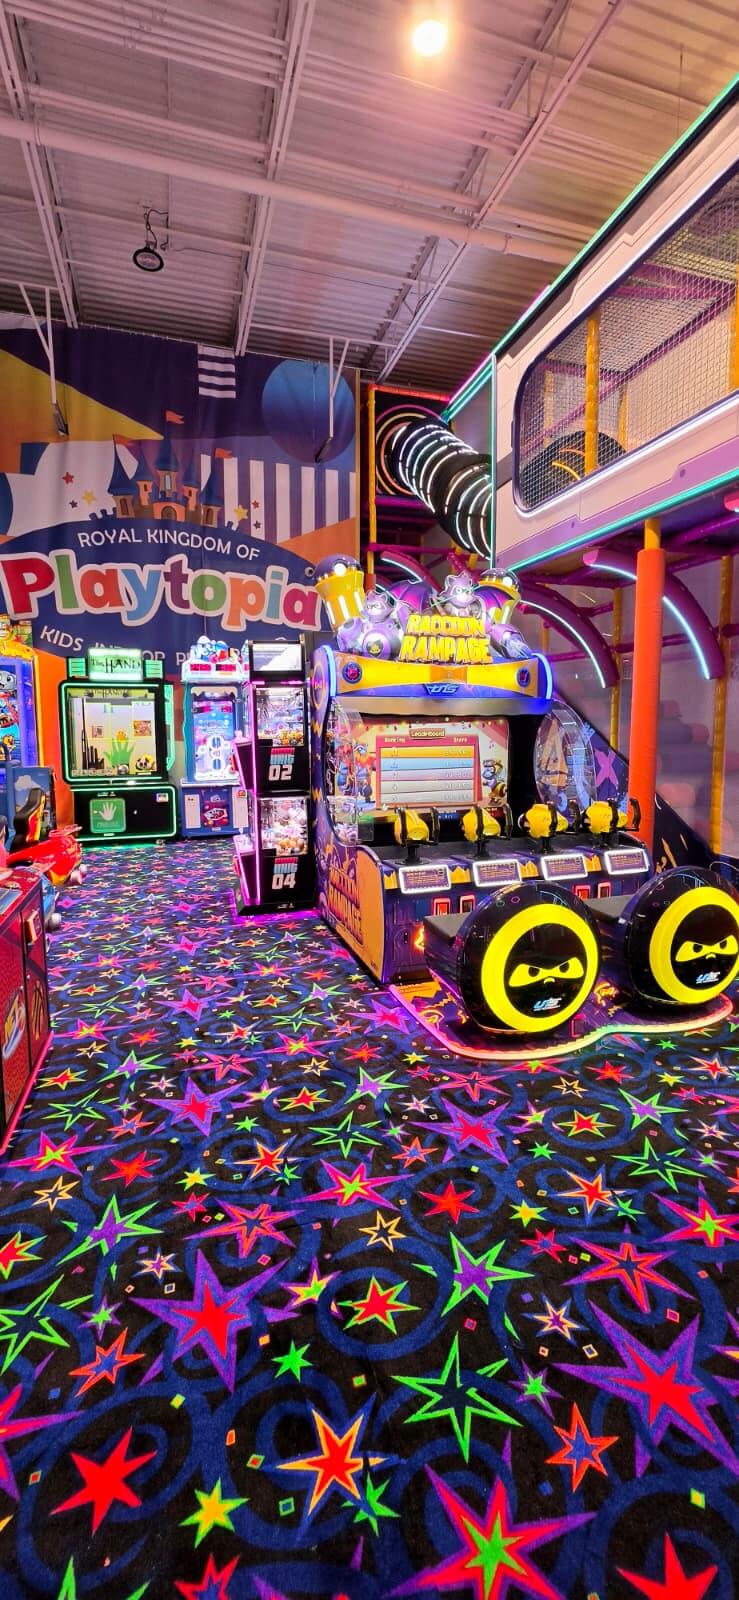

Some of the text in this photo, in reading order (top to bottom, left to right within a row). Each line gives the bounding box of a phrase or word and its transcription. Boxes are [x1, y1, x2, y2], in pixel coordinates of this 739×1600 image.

[77, 527, 261, 561] ROYAL KINGDOM OF
[1, 550, 320, 630] Playtopia
[40, 625, 84, 651] KIDS
[406, 613, 486, 637] RACCOON
[401, 635, 493, 664] RAMPAGE
[268, 764, 293, 781] 02
[271, 873, 296, 890] 04
